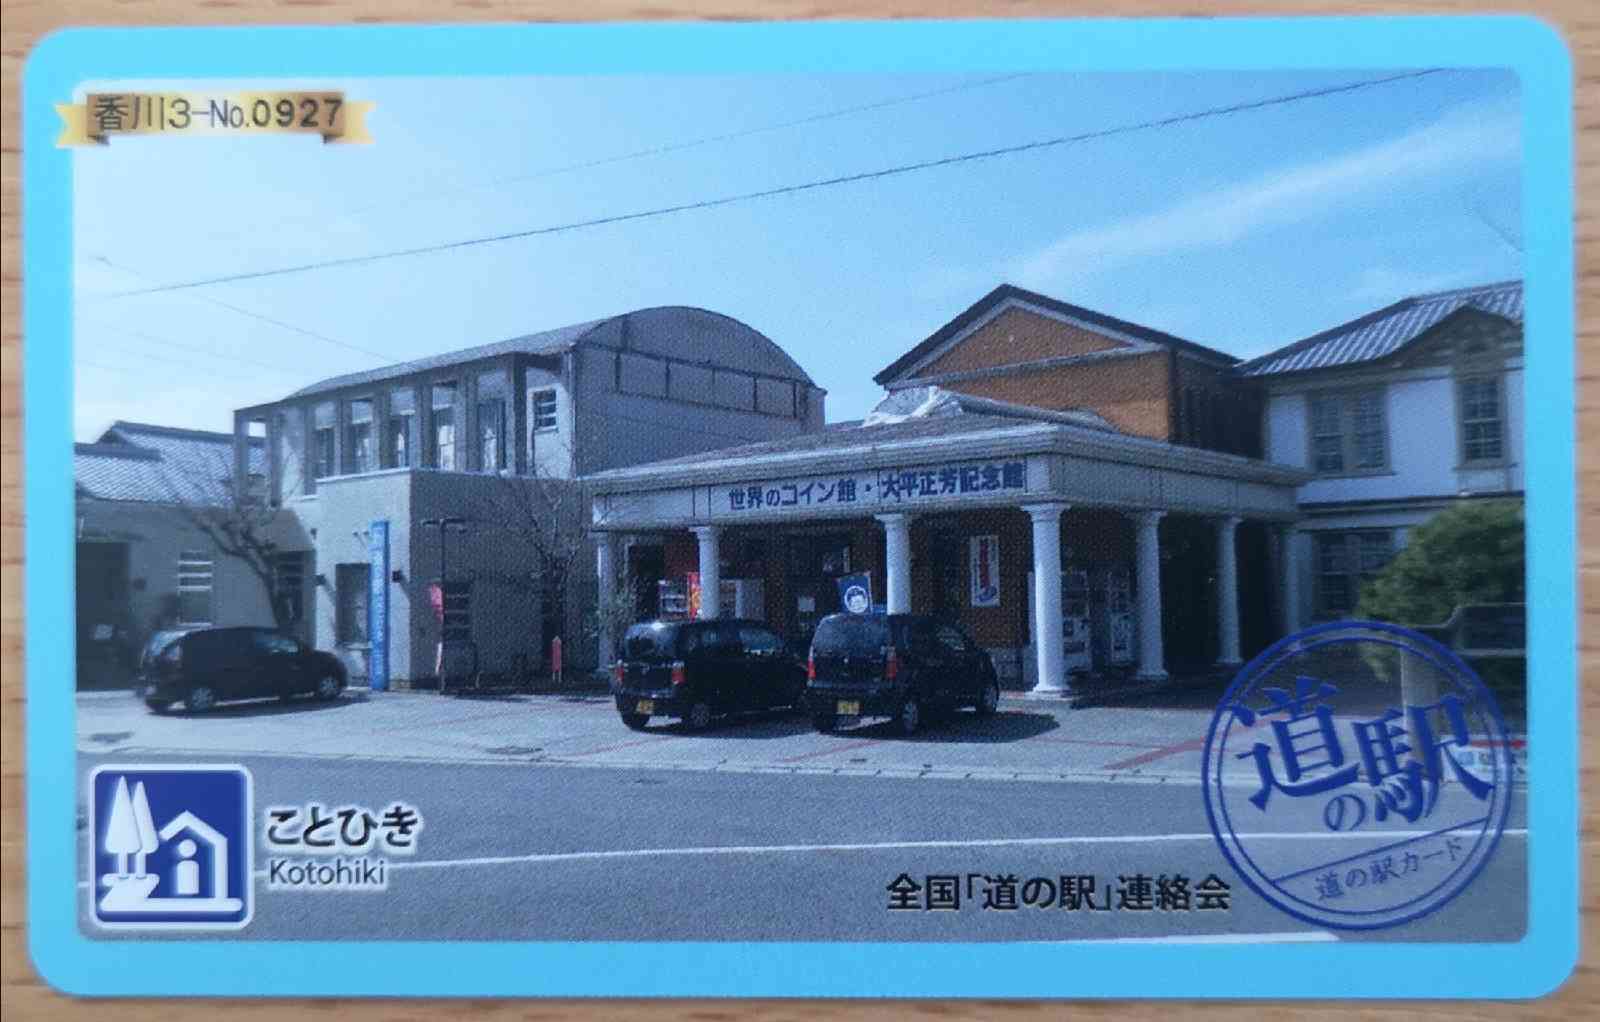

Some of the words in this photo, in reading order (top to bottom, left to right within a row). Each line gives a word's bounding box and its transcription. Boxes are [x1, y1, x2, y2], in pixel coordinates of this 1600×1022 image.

[267, 806, 418, 847] ことひき
[269, 859, 385, 885] Kotohiki
[1313, 838, 1463, 900] 道の駅カード
[886, 873, 1231, 911] 全国「道の駅」連絡会
